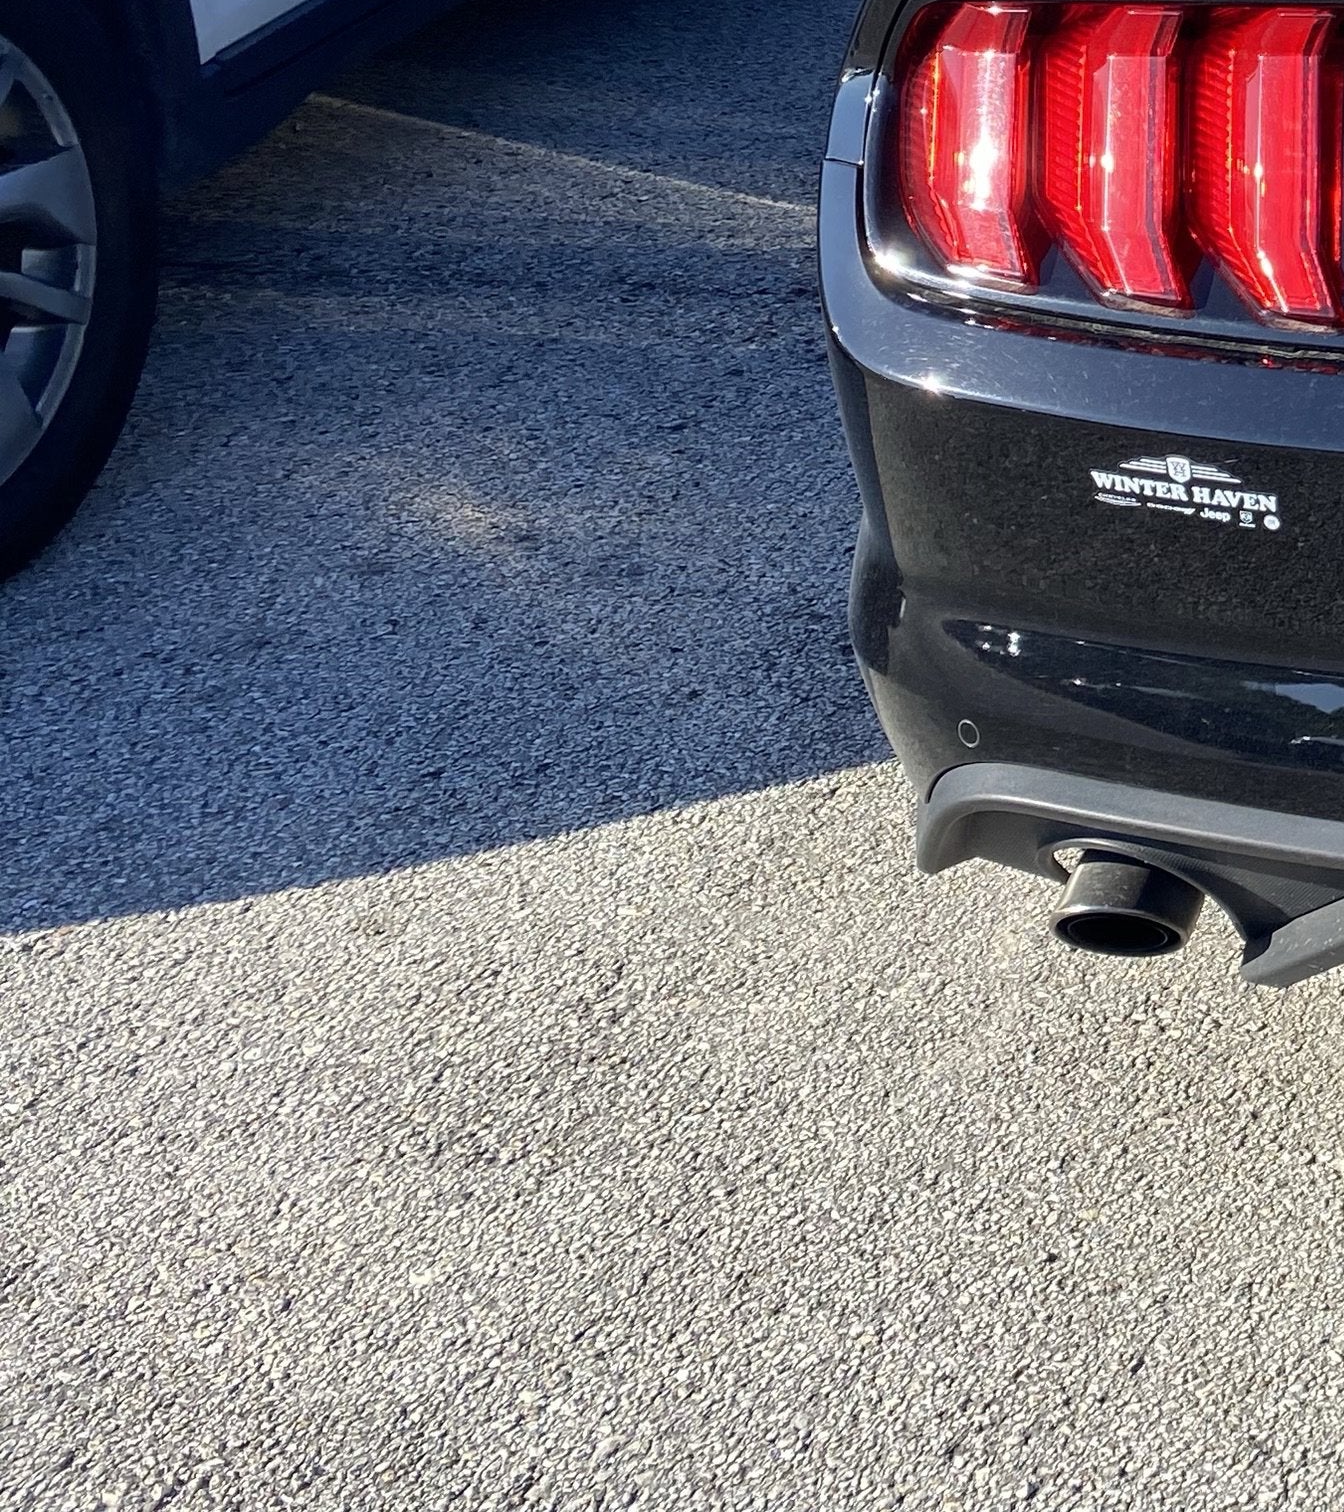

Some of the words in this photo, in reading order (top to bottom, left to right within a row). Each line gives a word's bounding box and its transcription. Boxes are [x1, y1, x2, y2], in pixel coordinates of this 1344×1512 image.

[1090, 471, 1189, 501] WINTER
[1191, 486, 1277, 513] HAVEN
[1199, 507, 1231, 522] Jeep
